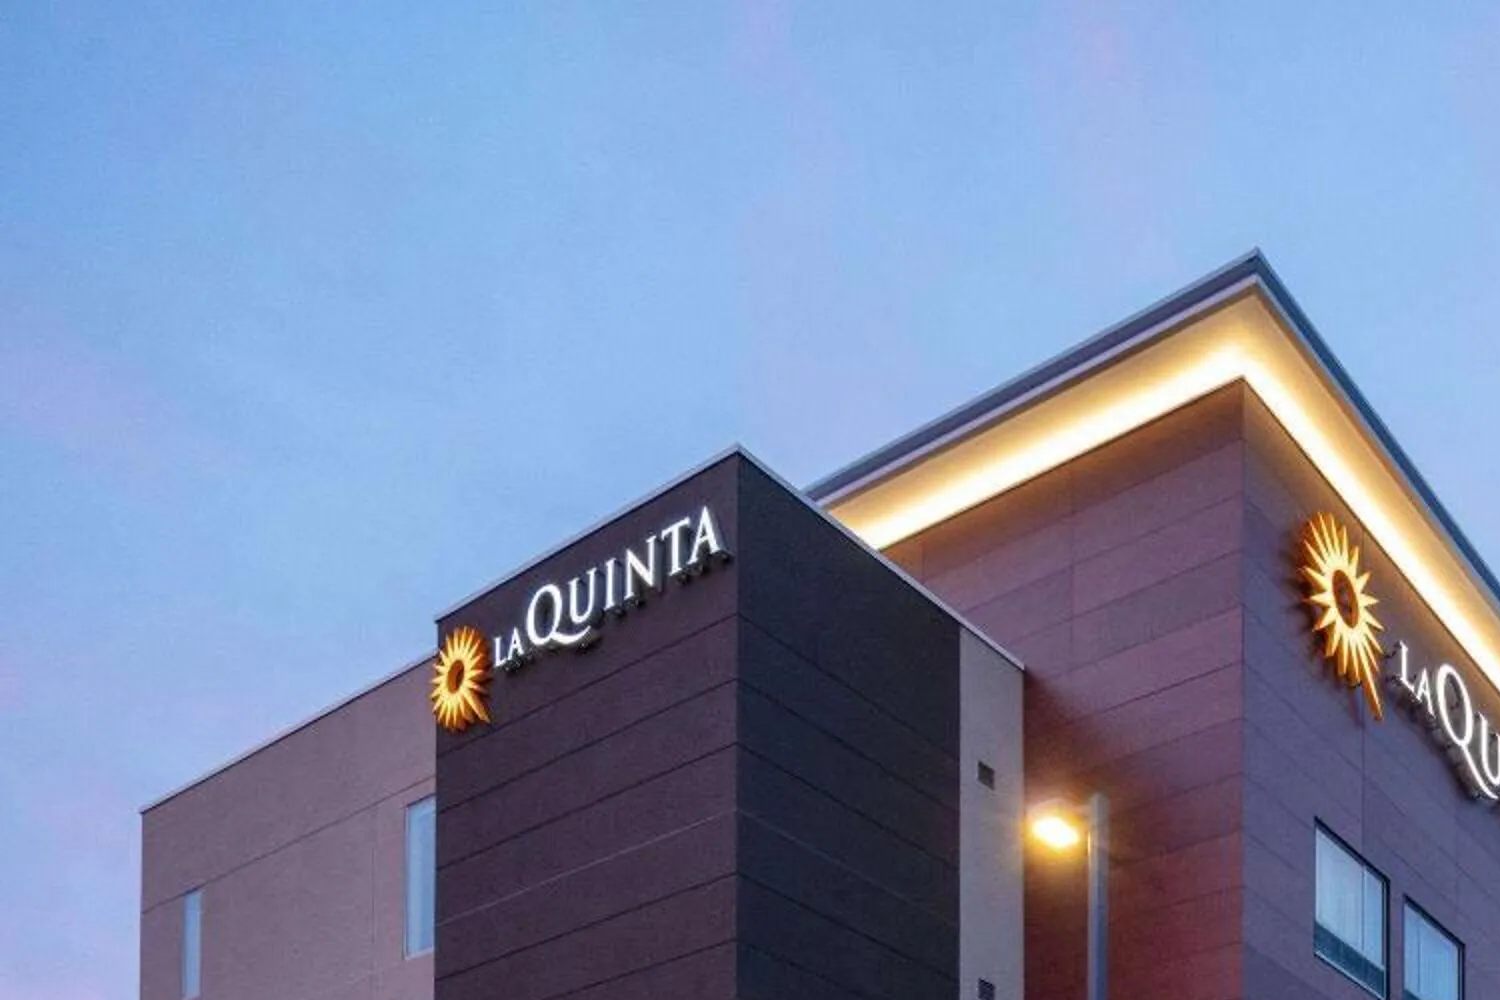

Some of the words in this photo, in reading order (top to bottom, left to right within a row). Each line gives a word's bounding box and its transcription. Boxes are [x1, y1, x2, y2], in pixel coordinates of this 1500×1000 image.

[493, 626, 525, 668] LA
[526, 505, 724, 644] QUINTA
[1399, 640, 1436, 718] LA
